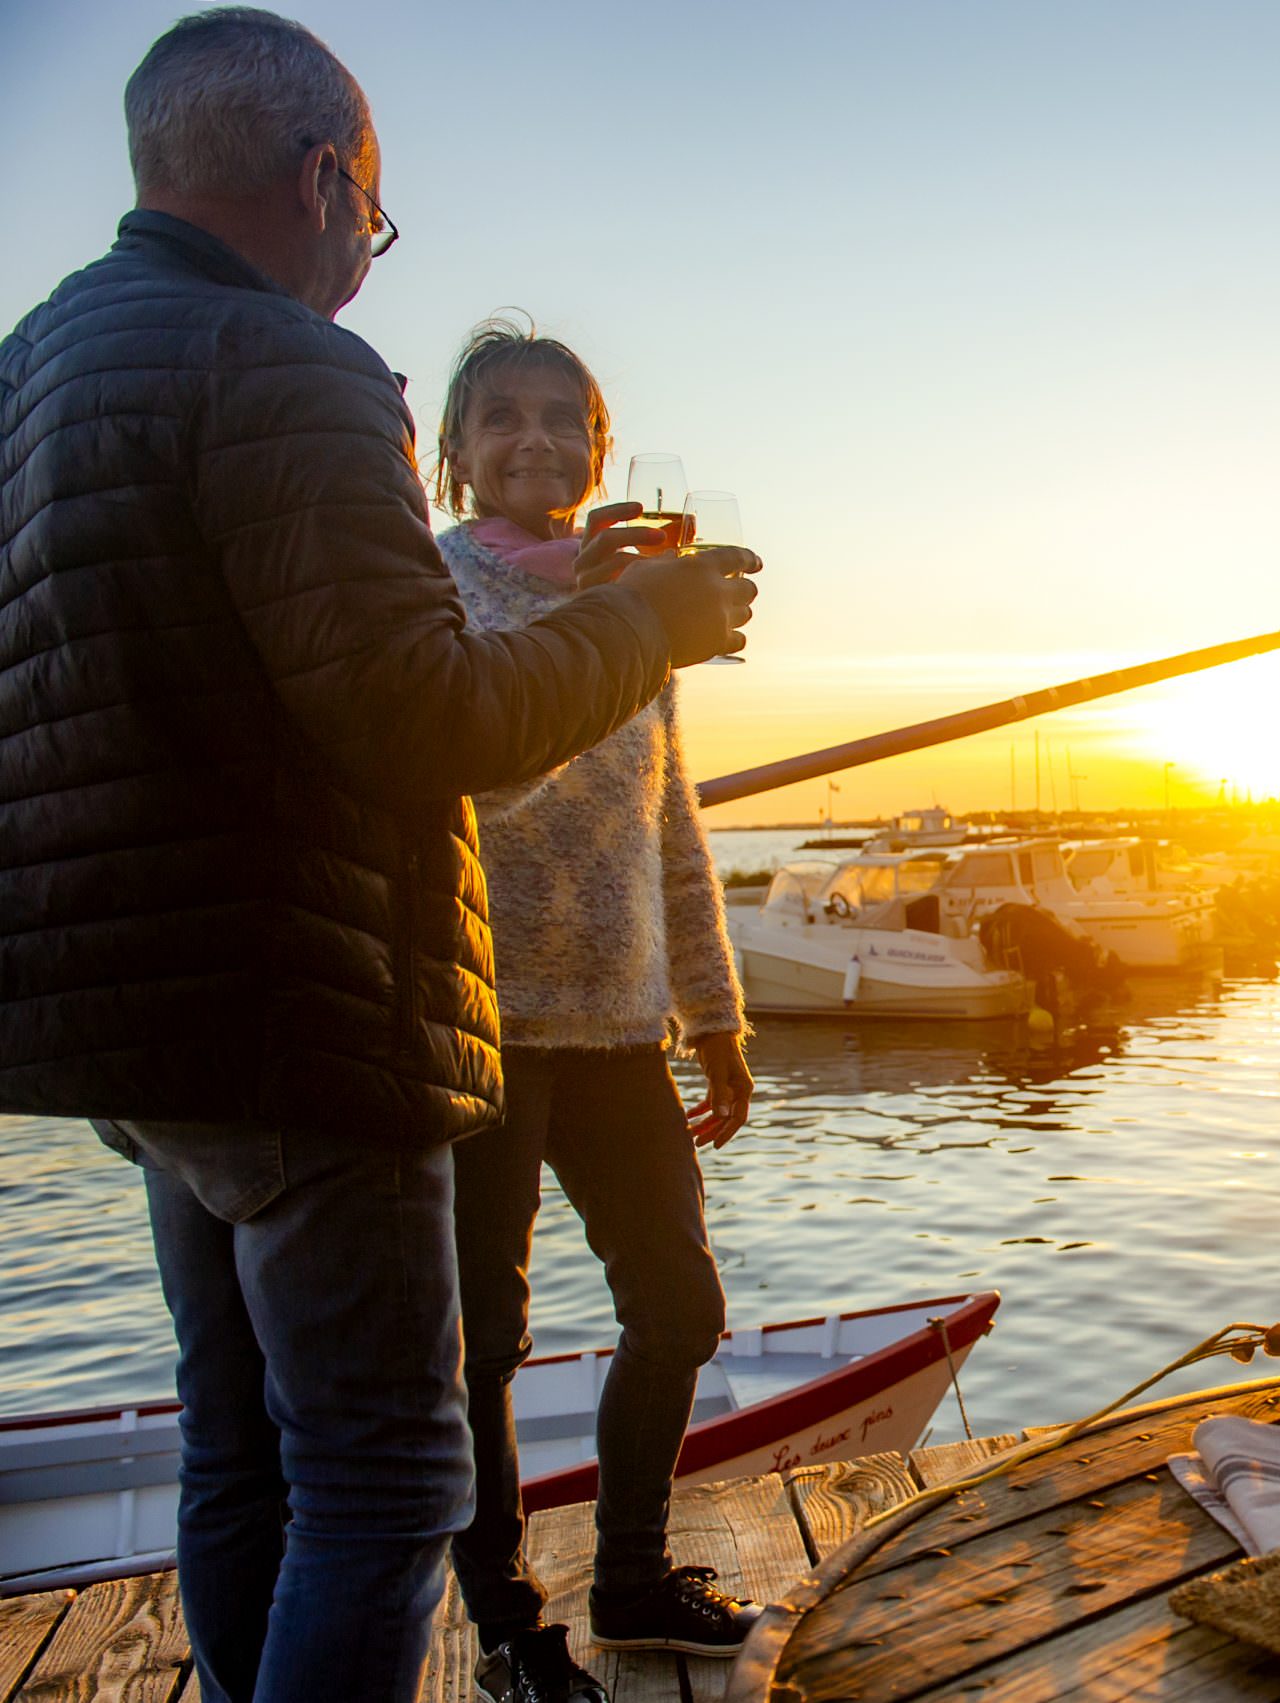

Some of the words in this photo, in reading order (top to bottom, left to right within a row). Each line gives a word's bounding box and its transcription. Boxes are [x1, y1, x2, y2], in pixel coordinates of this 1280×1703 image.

[769, 1444, 802, 1473] Les
[809, 1428, 852, 1456] deux
[860, 1406, 894, 1442] pins
